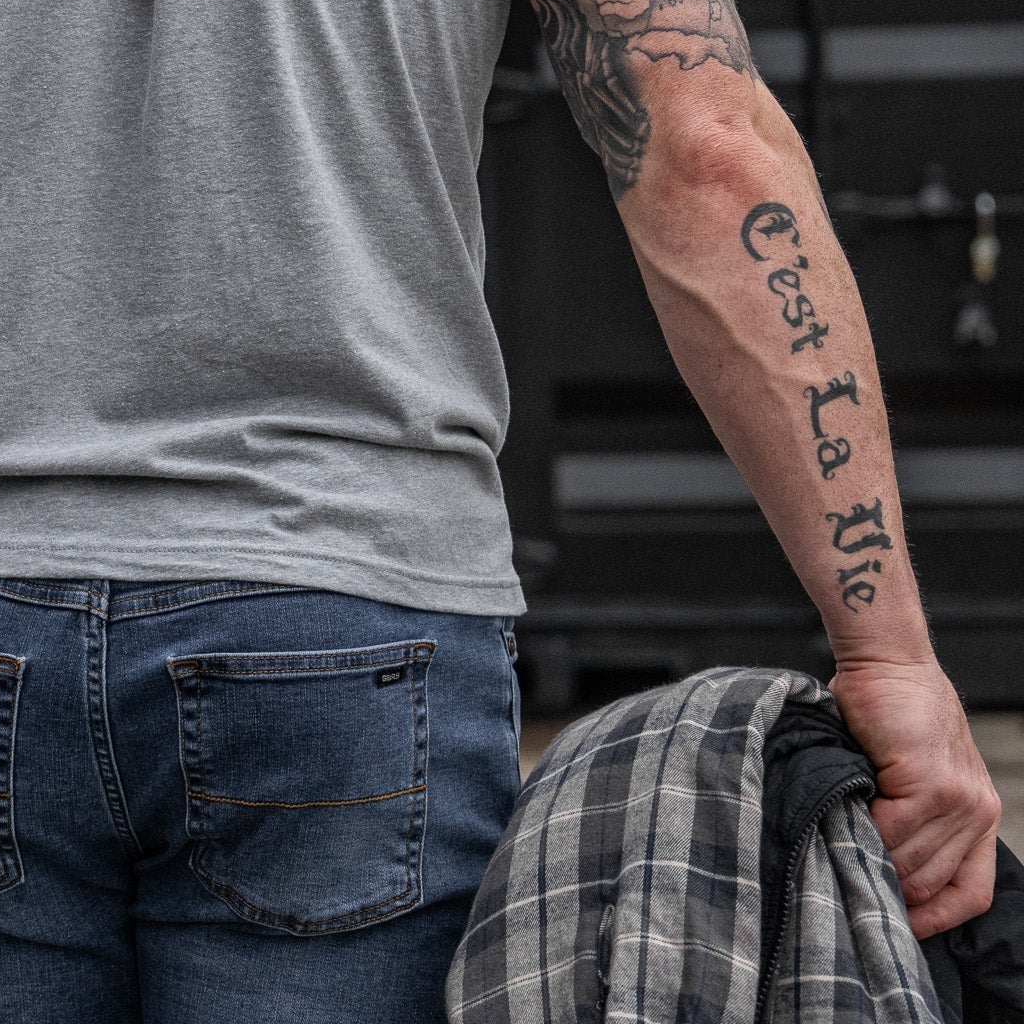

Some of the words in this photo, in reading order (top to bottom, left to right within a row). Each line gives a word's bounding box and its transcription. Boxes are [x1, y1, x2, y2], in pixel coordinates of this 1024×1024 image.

[740, 202, 830, 355] C'est
[803, 371, 861, 481] La
[825, 497, 894, 614] Vie
